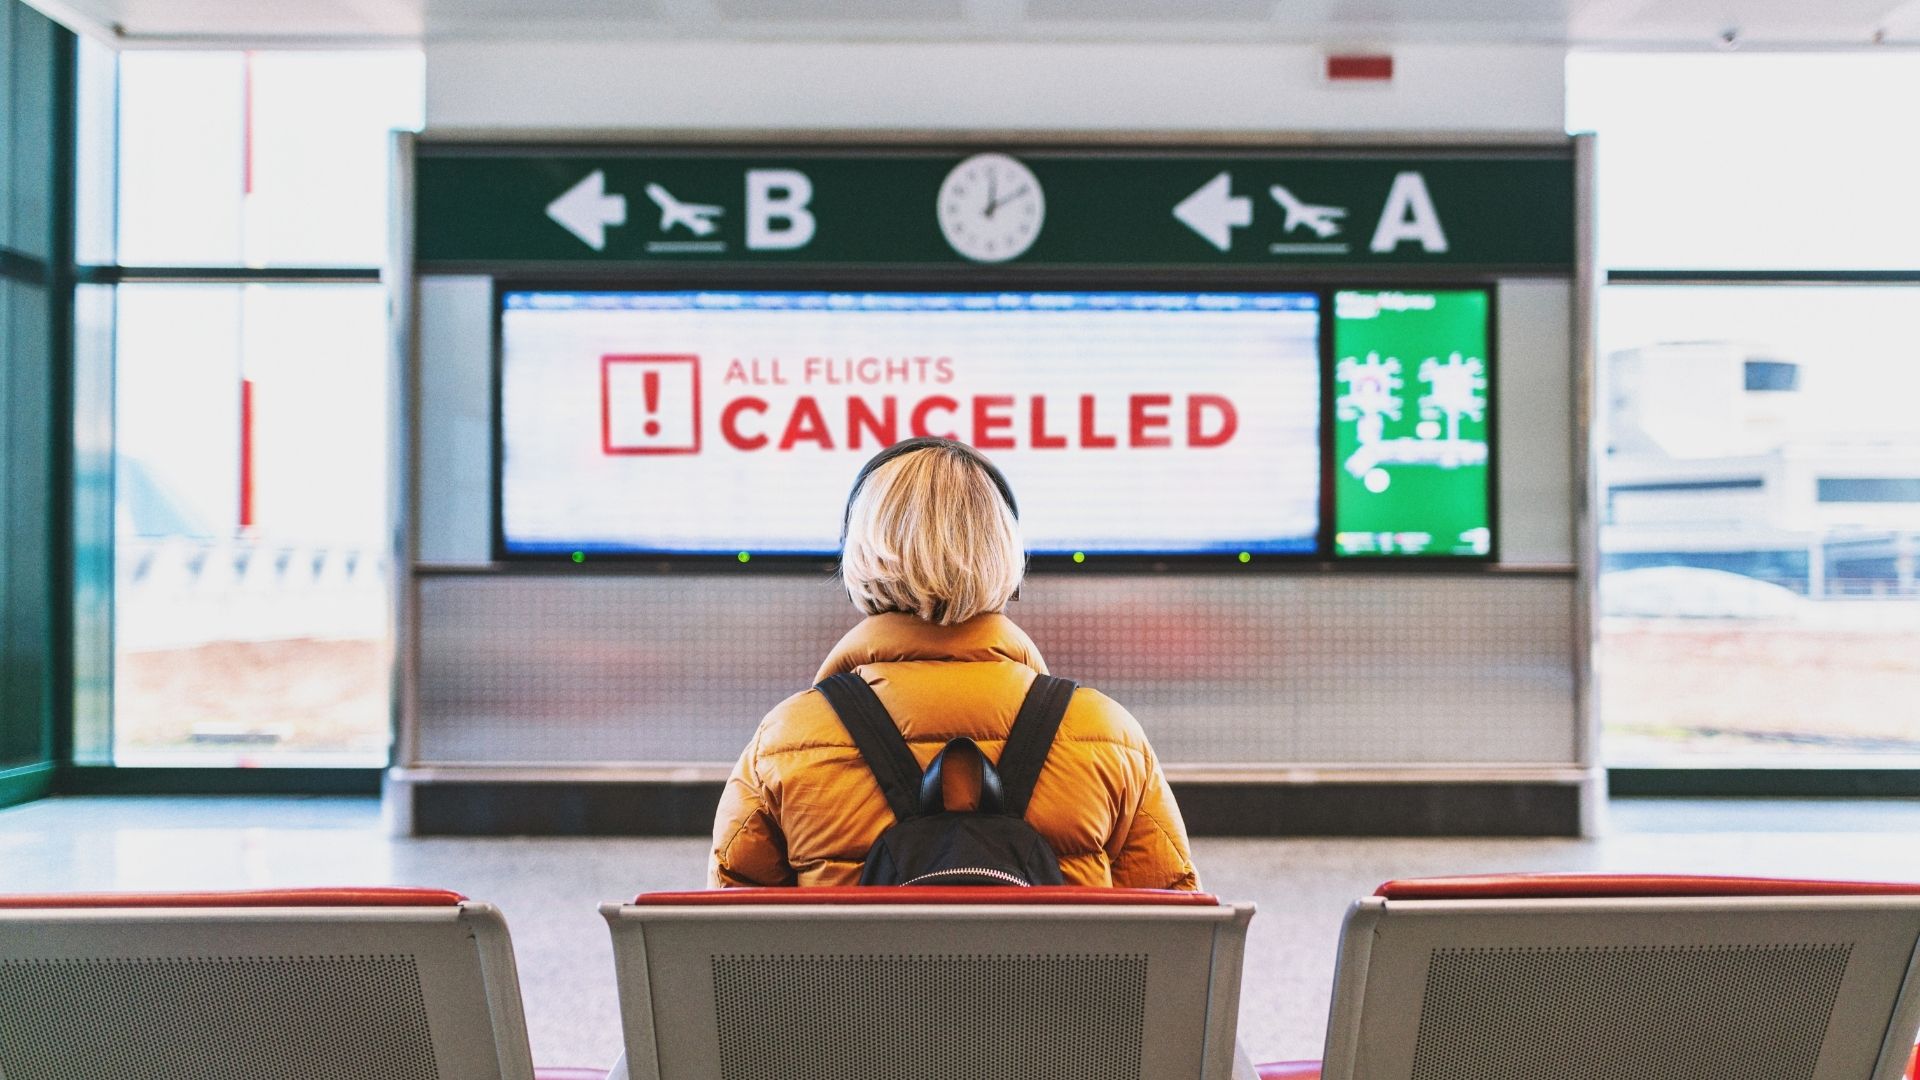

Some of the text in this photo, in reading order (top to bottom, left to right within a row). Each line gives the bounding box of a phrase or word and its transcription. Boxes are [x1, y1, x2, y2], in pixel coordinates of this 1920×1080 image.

[745, 168, 816, 249] B
[1369, 171, 1448, 252] A
[724, 357, 955, 384] ALL FLIGHTS
[720, 394, 1238, 451] CANCELLED
